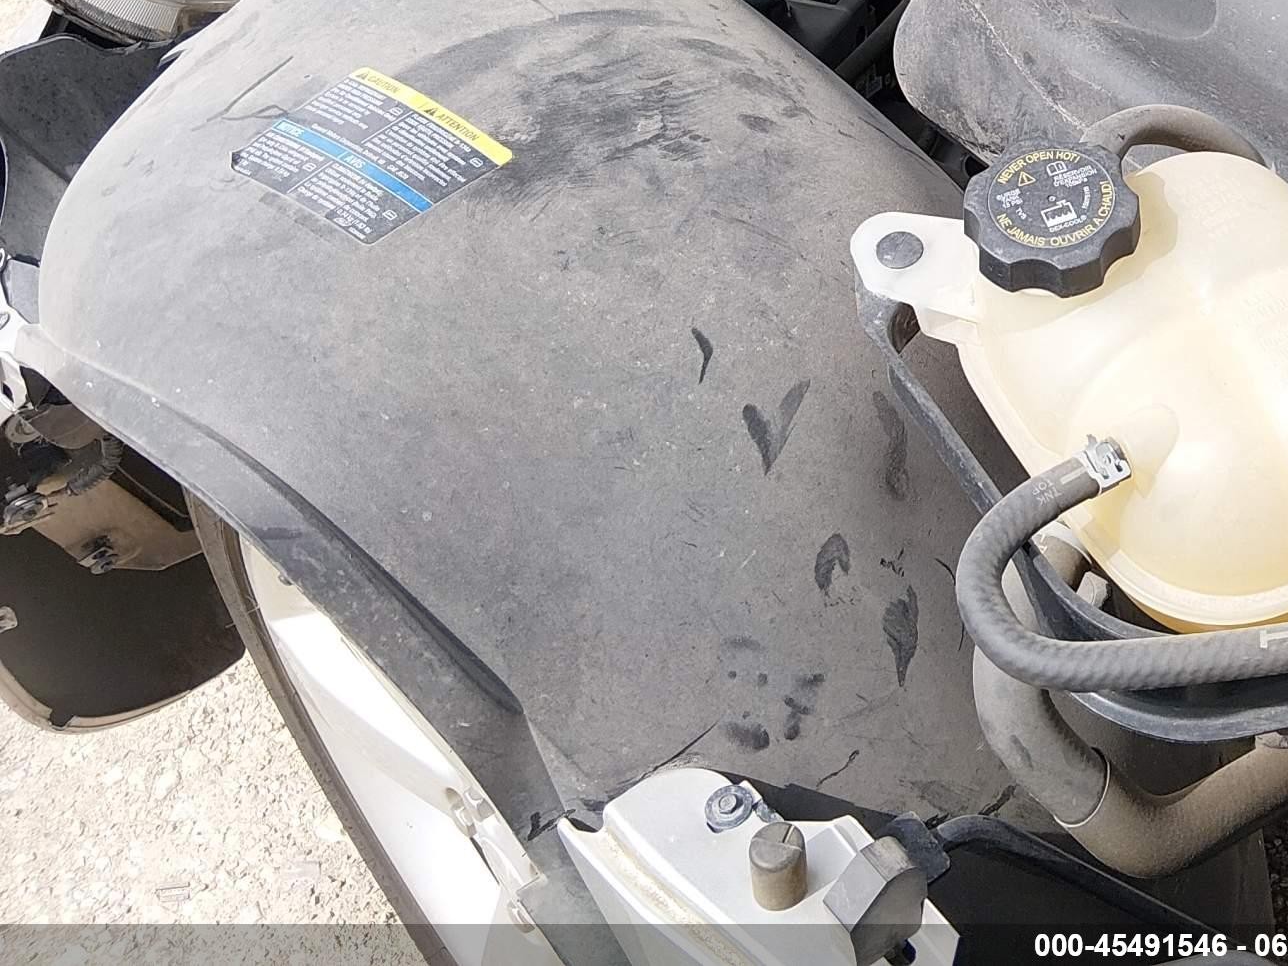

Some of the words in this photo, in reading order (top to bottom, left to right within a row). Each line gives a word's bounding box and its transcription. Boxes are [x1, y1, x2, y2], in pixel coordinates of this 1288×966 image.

[368, 75, 401, 93] CAUTION
[276, 121, 305, 137] NOTICE
[435, 113, 480, 141] ATTENTION
[344, 155, 366, 169] AVIS
[997, 160, 1026, 184] NEVER
[1026, 151, 1054, 164] OPEN
[1056, 150, 1080, 163] HOT!
[996, 213, 1012, 230] NE
[1006, 226, 1046, 246] JAMAIS
[1050, 224, 1096, 246] OUVRIR
[1098, 181, 1114, 217] CHAUD!
[1032, 478, 1054, 496] TOP
[1036, 486, 1062, 507] TNK
